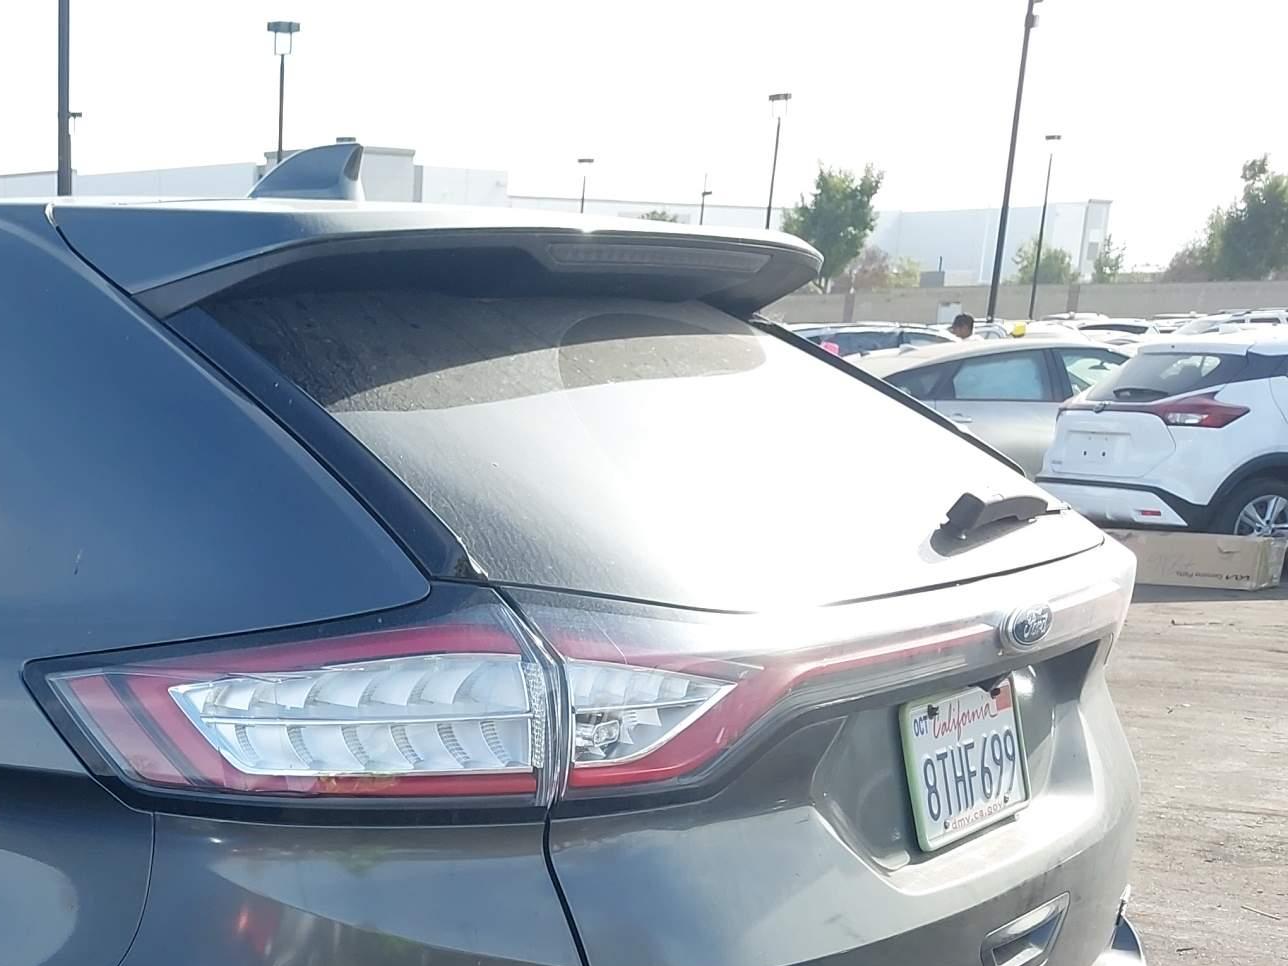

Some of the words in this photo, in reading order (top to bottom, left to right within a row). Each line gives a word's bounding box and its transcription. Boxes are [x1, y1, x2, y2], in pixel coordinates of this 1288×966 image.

[913, 713, 929, 737] OCT
[932, 698, 998, 741] California
[951, 801, 1004, 831] dmv.ca.gov
